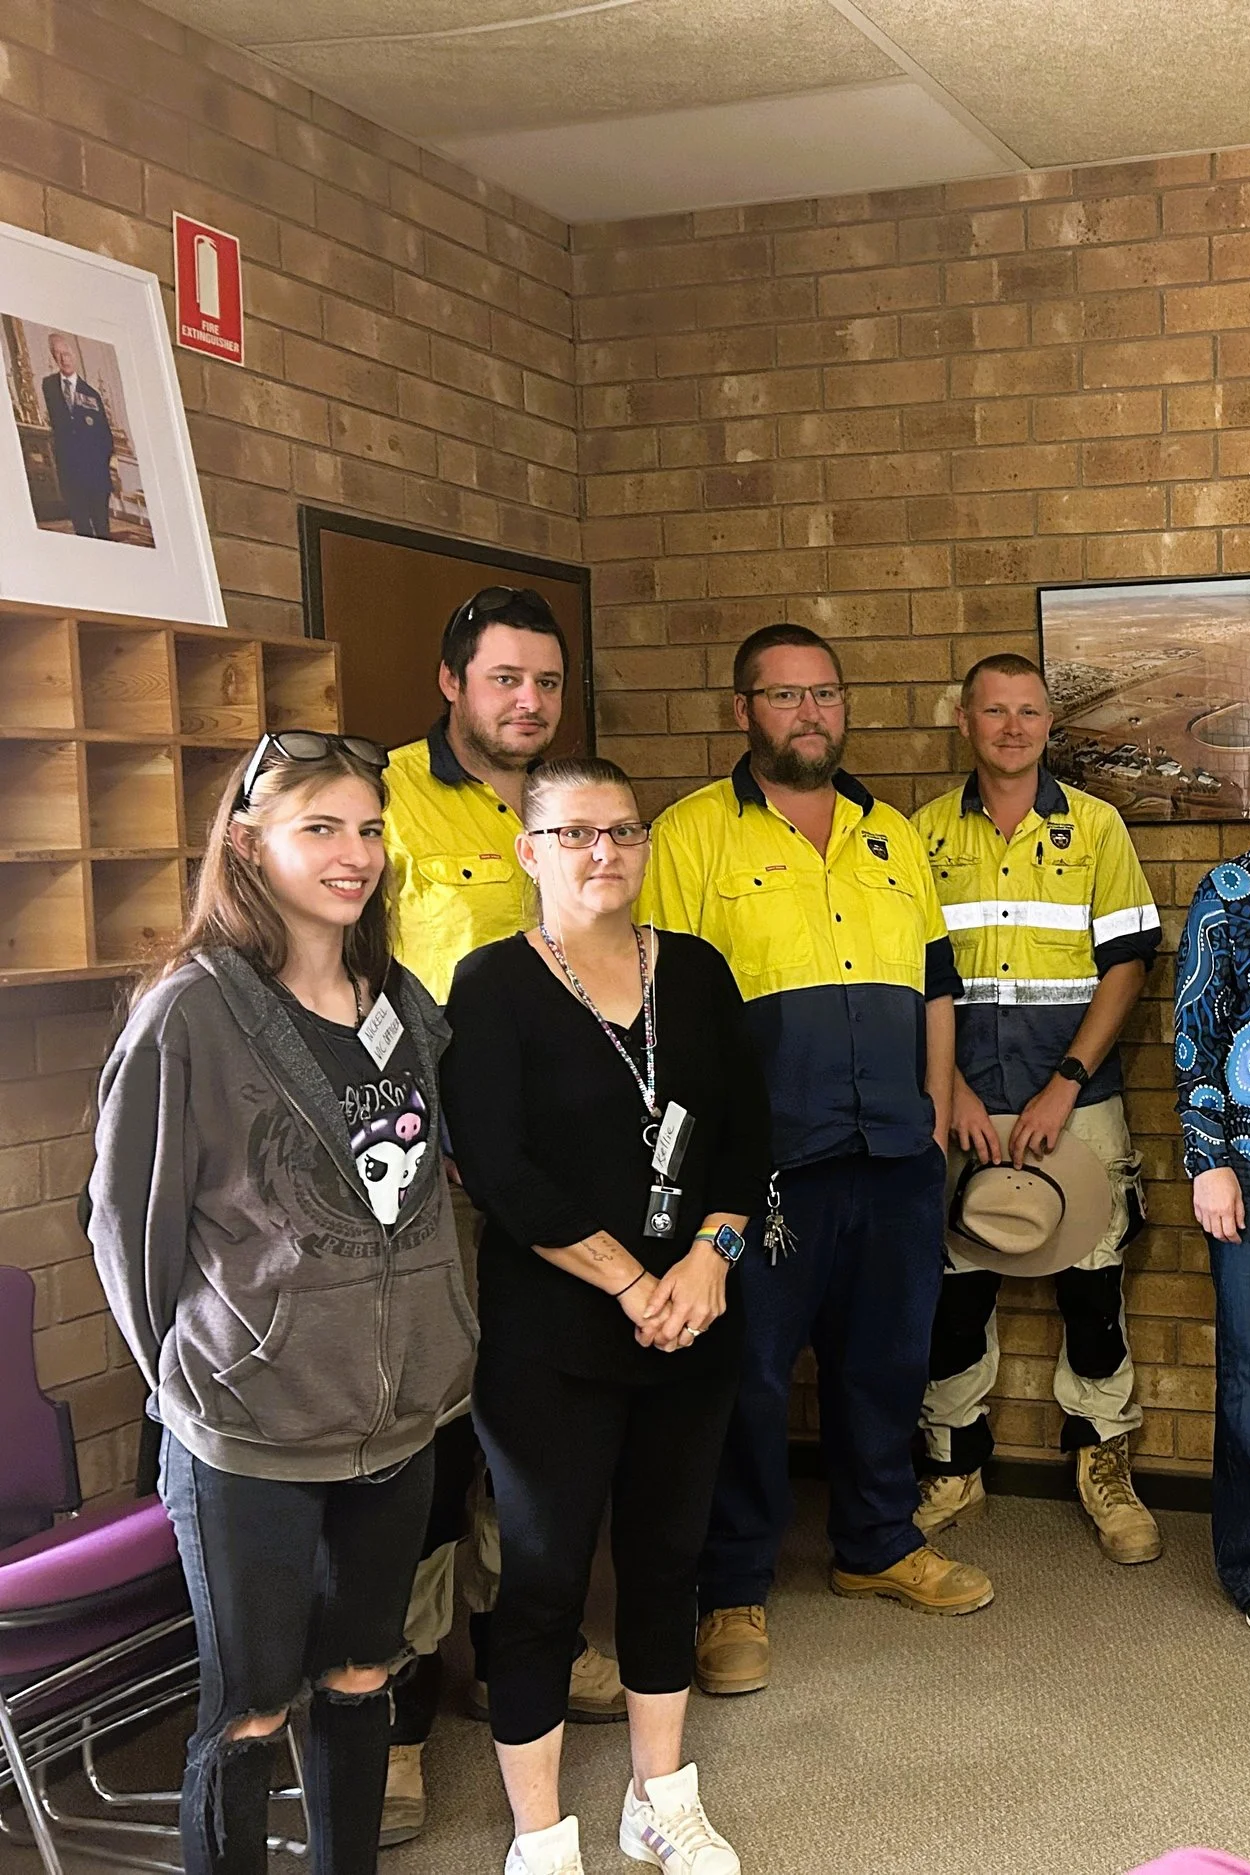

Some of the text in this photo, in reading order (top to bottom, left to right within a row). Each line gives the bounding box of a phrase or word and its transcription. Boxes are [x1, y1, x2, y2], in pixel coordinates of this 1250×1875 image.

[181, 324, 240, 353] EXTINGUISHER
[202, 320, 220, 336] FIRE
[656, 1125, 675, 1168] Kellie
